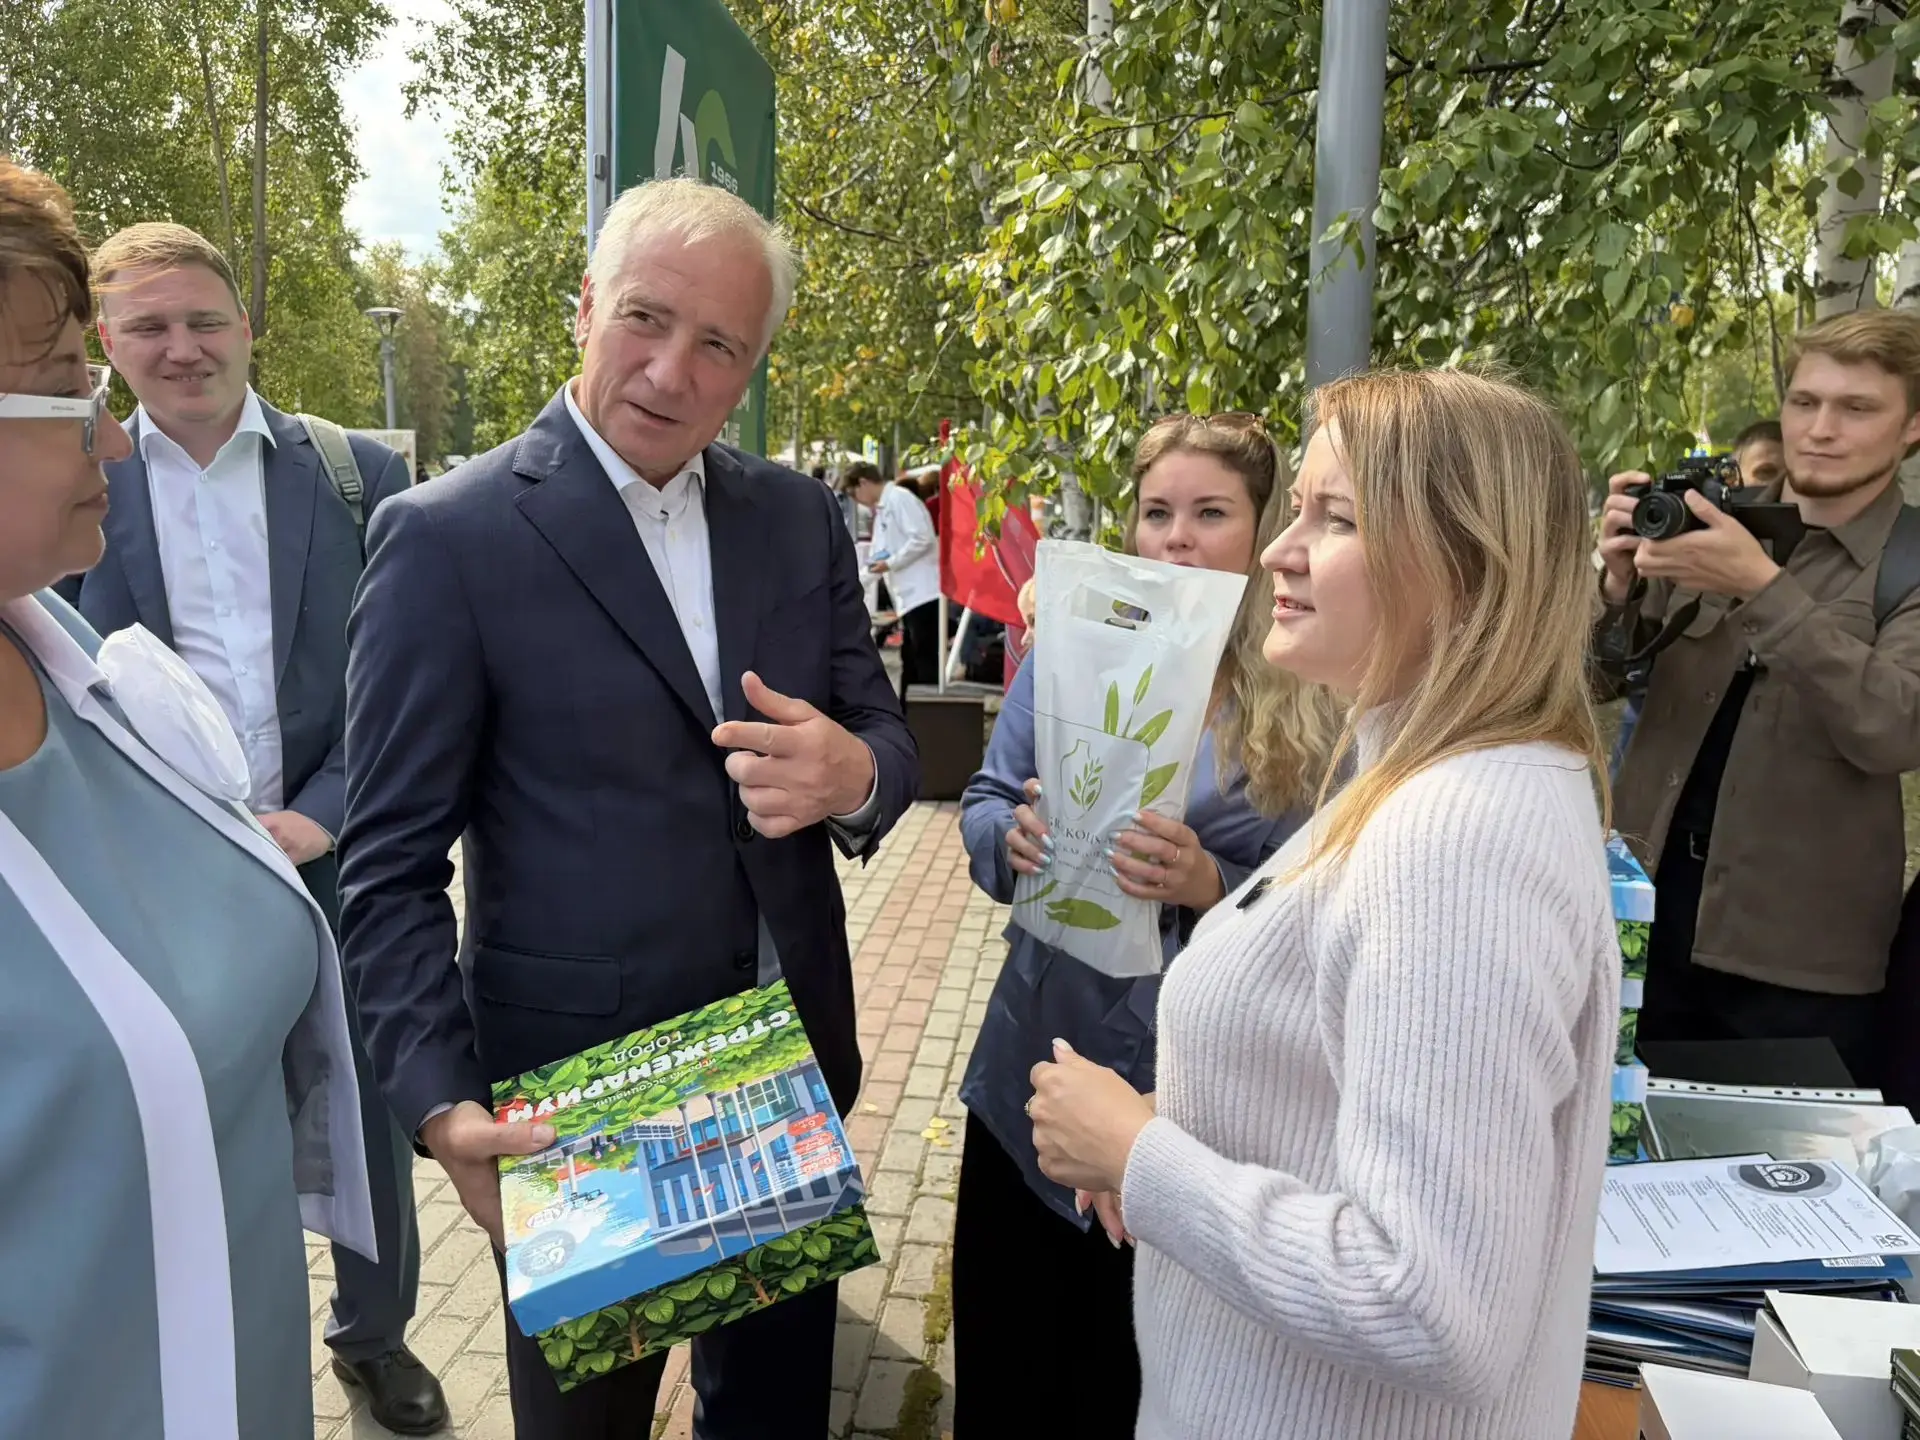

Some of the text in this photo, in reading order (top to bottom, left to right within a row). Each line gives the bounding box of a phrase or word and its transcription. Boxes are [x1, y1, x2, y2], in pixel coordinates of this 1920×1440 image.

[710, 160, 738, 194] 1966
[507, 1010, 791, 1123] СТРЕЖЕНАРИУМ
[612, 1031, 683, 1064] ГОРОД
[592, 1058, 716, 1108] игра на ассоциации
